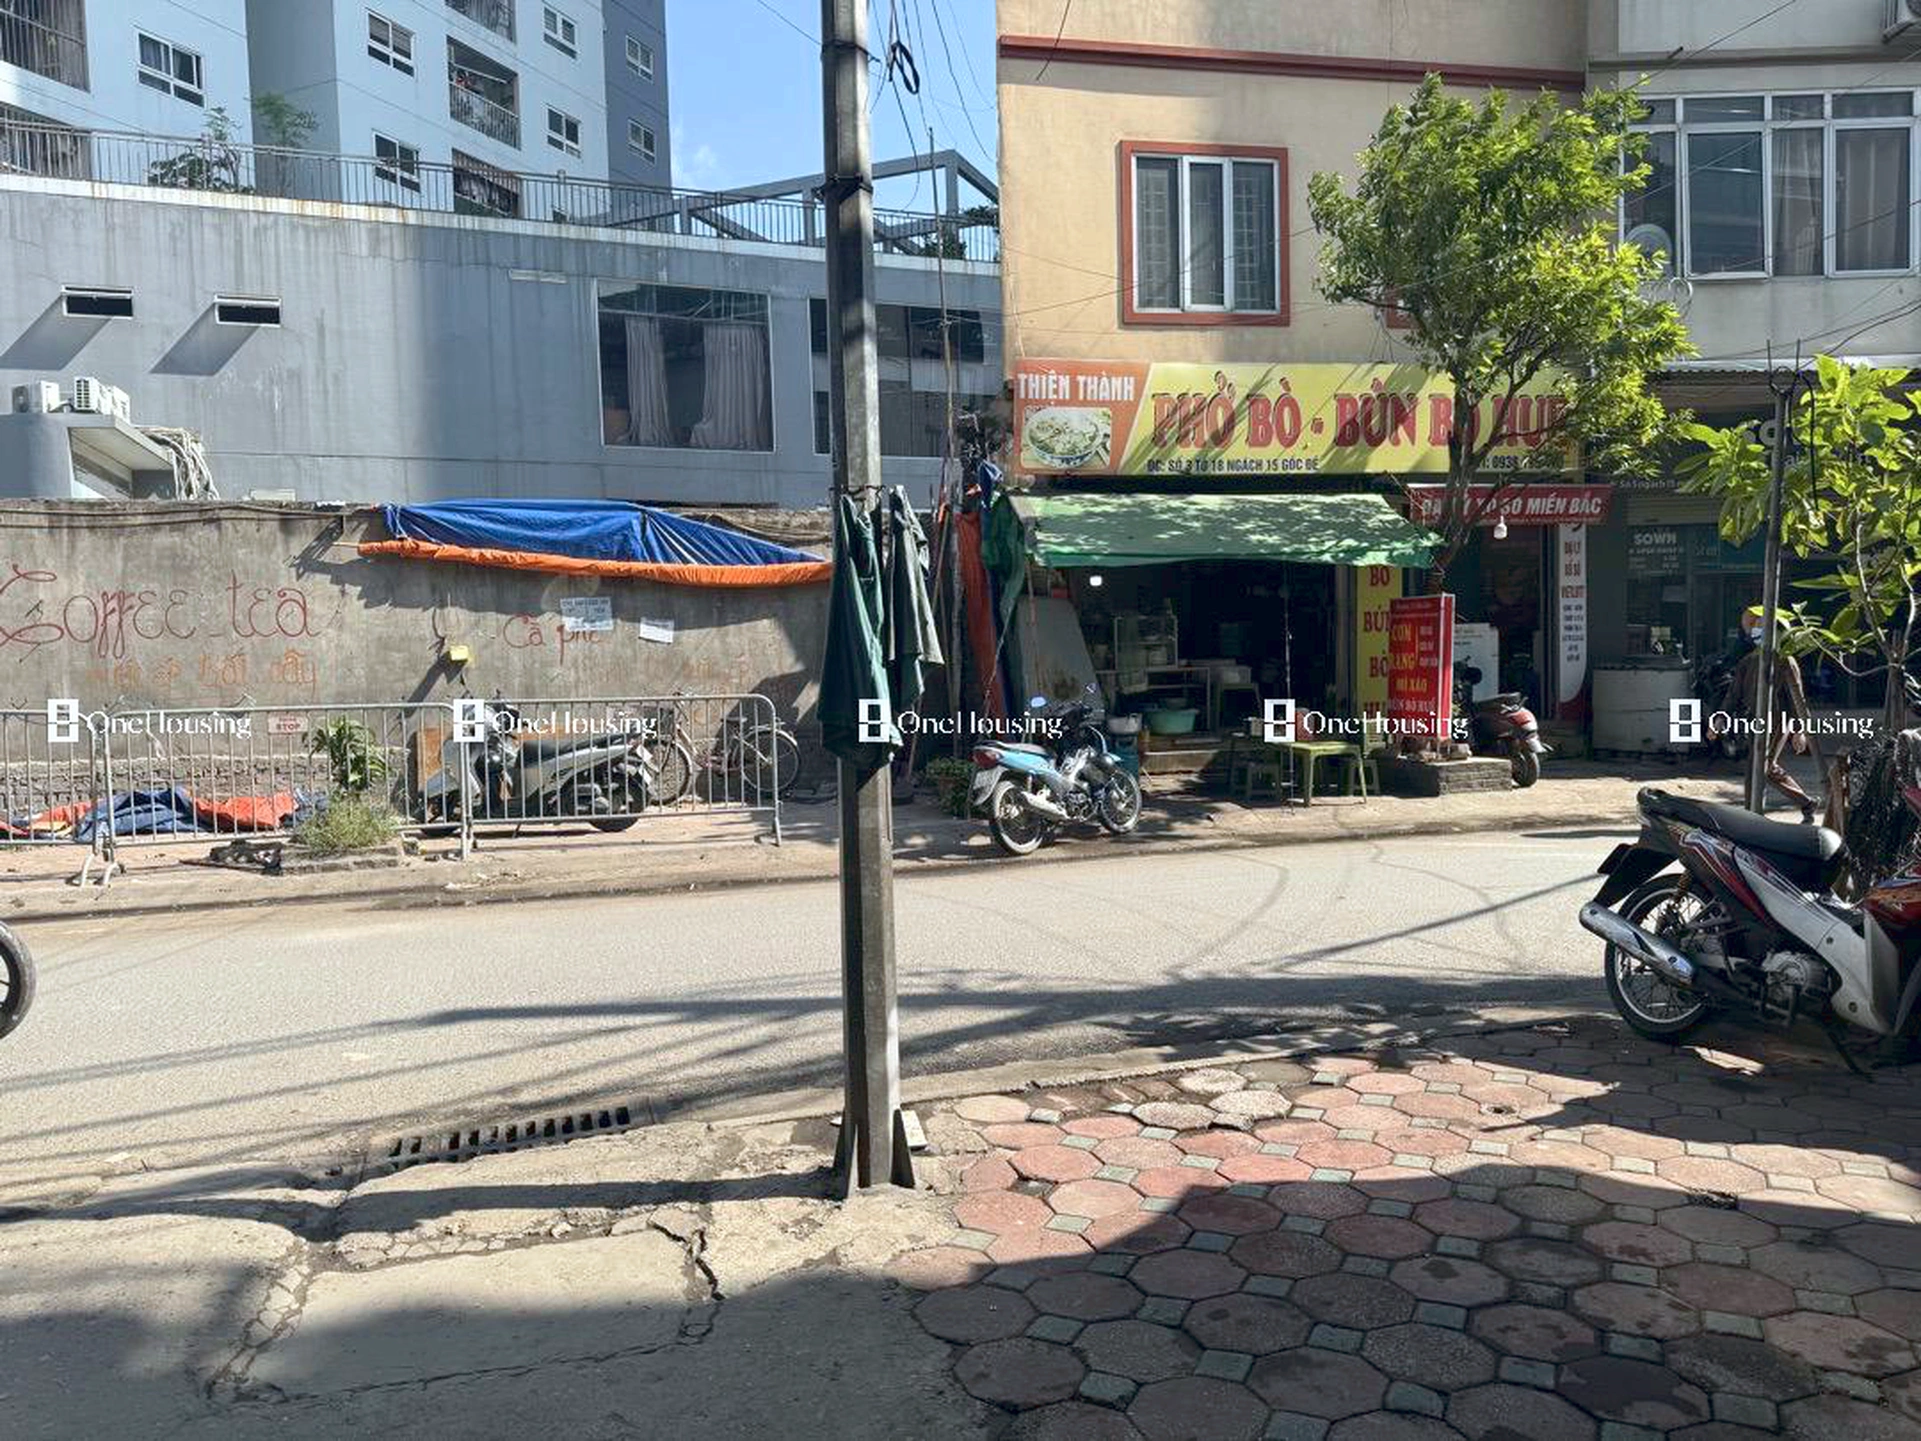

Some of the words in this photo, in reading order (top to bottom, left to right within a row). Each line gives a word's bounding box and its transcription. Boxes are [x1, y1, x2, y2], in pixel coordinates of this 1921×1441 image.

[1017, 369, 1070, 405] THIỆN
[1076, 370, 1135, 401] THÀNH
[1151, 370, 1237, 449] PHỞ
[1244, 376, 1303, 448] BÒ
[1211, 458, 1224, 472] 18
[1266, 458, 1278, 472] 15
[226, 569, 321, 638] tea
